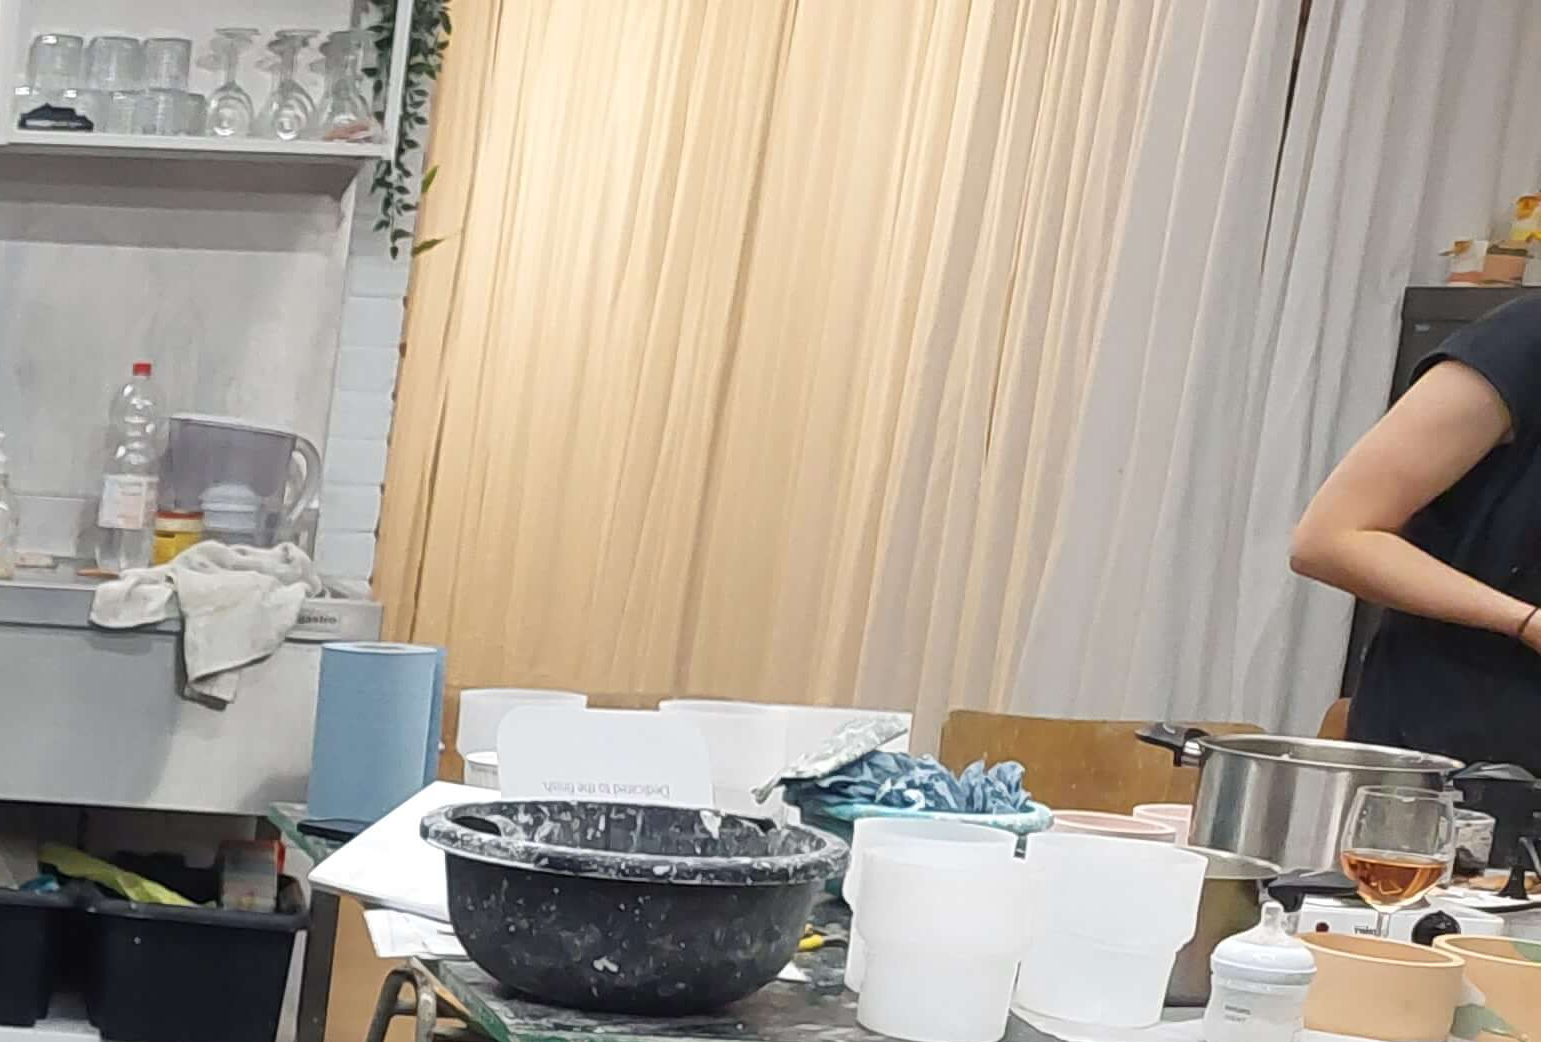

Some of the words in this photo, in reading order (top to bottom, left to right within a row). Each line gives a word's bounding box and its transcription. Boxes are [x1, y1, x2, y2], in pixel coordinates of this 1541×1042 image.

[577, 782, 596, 795] the
[597, 782, 611, 795] to
[613, 783, 670, 799] Dedicated
